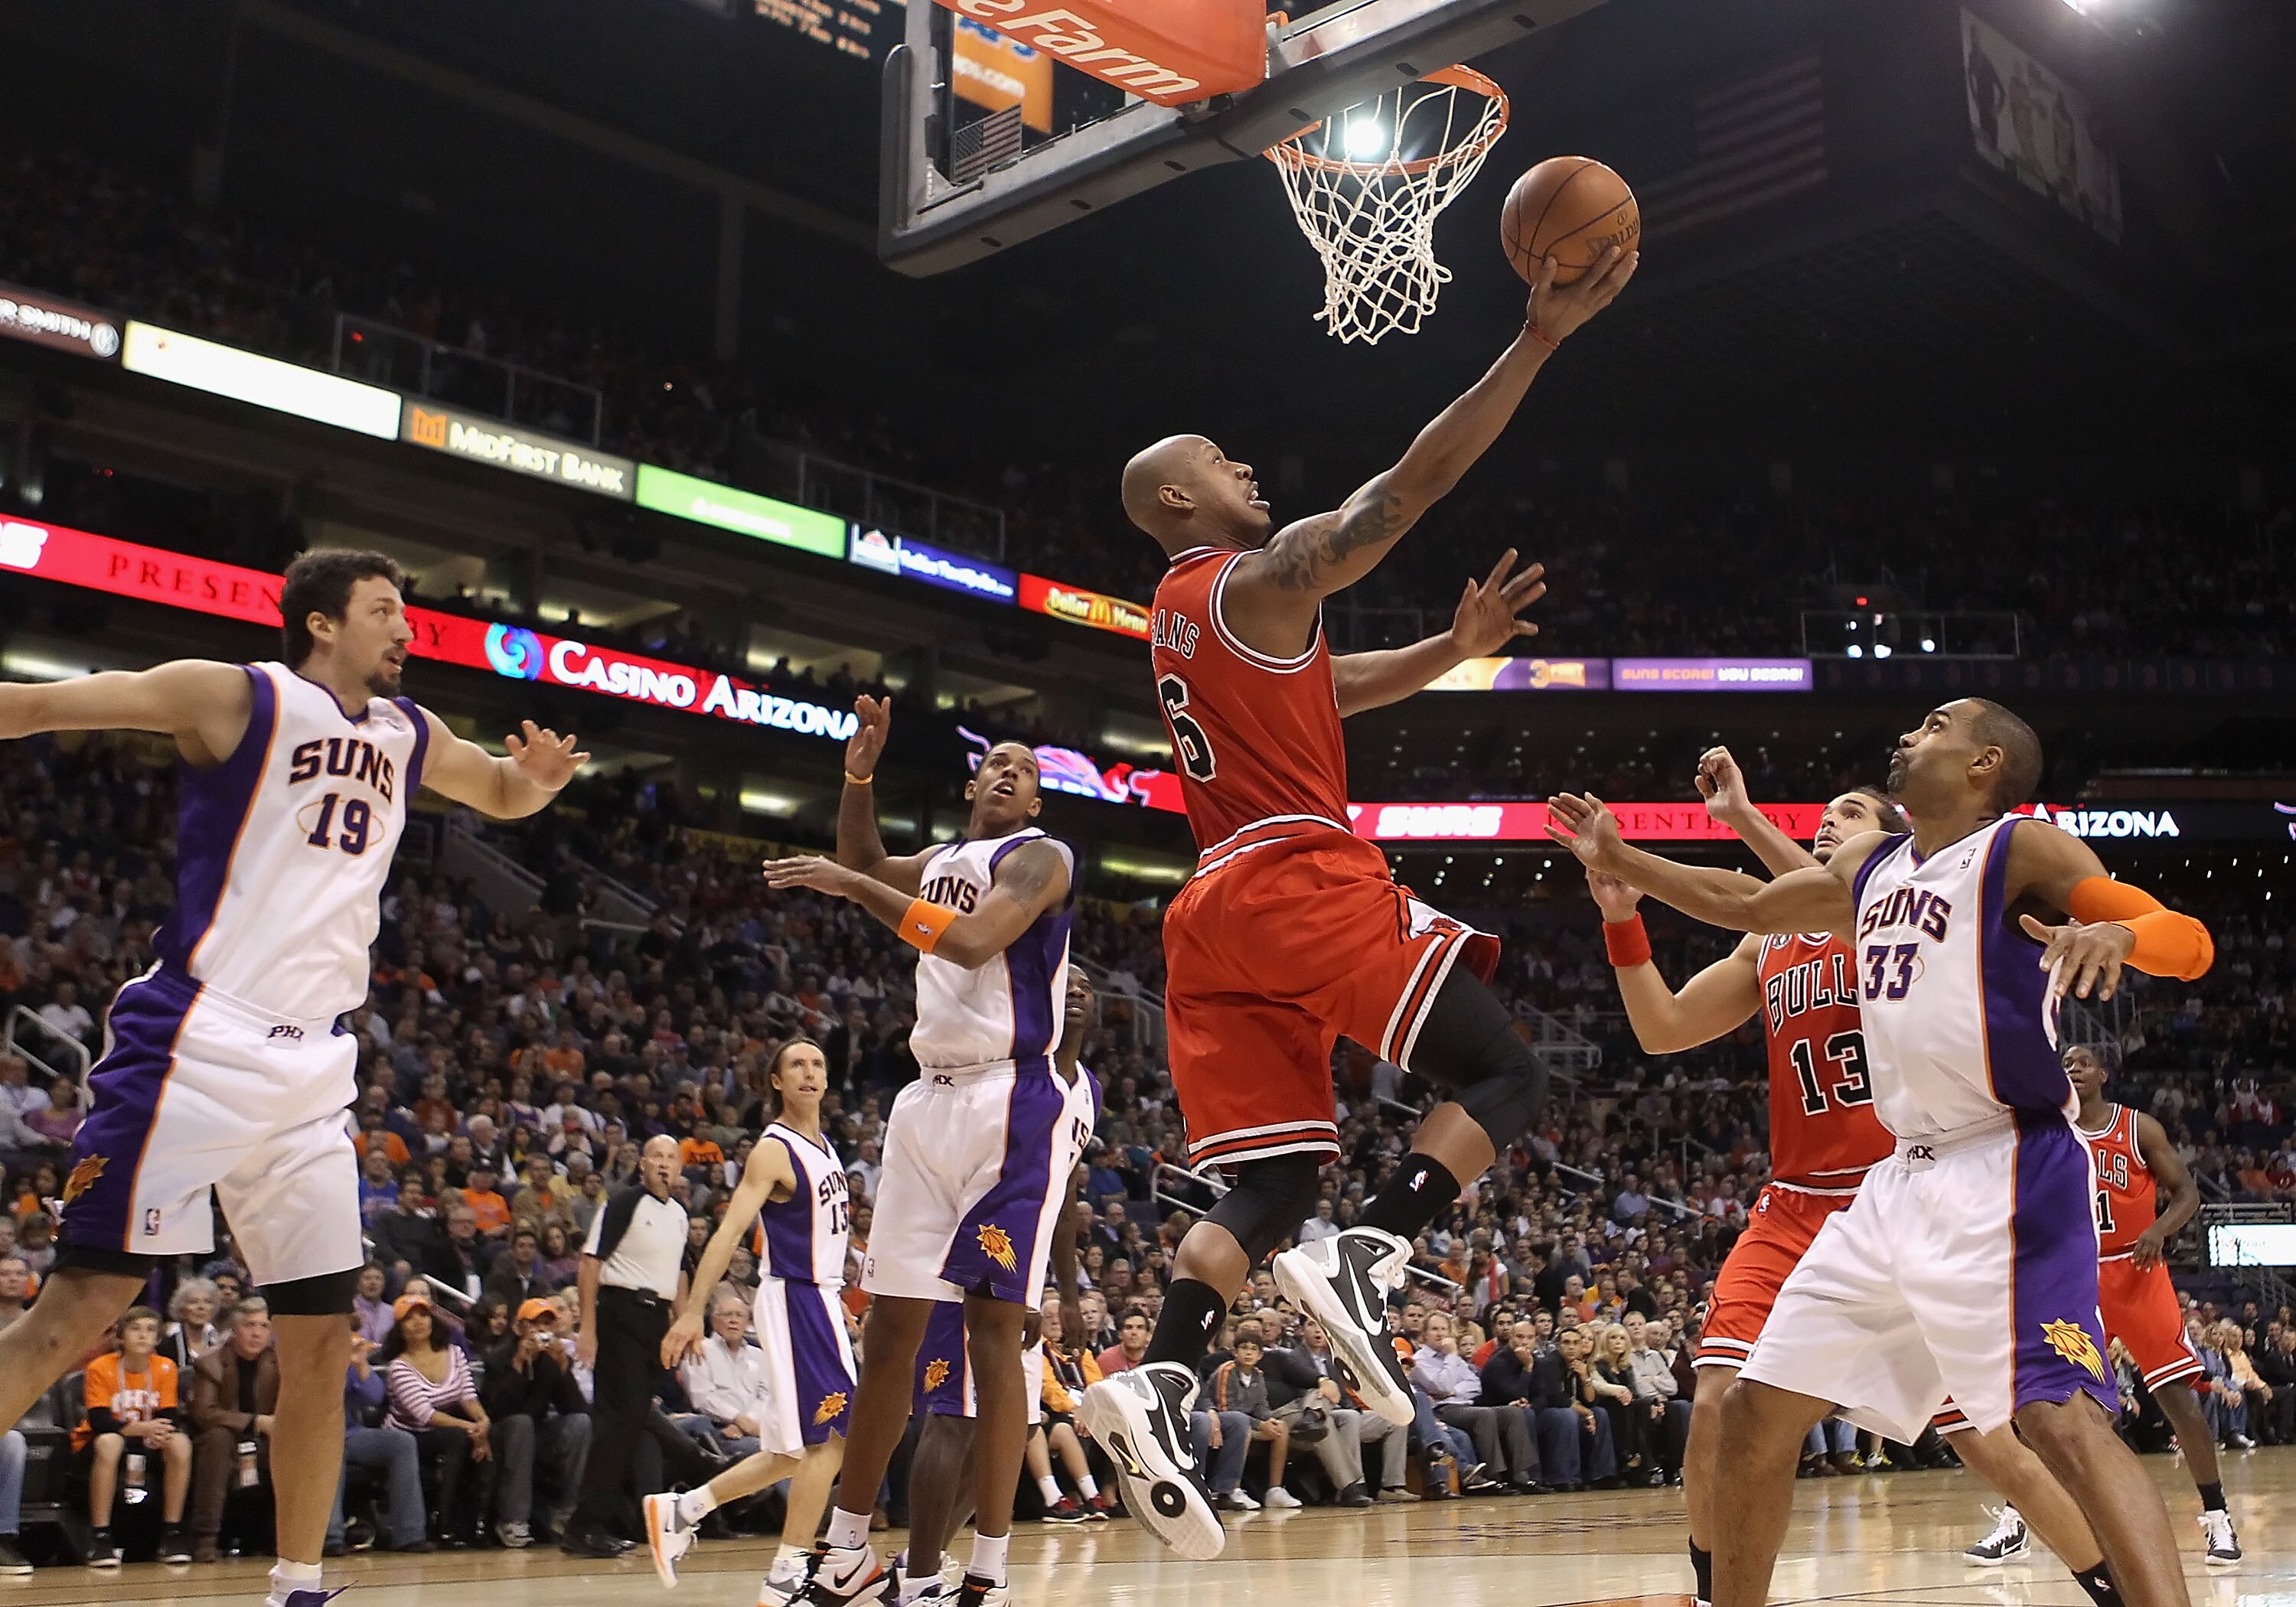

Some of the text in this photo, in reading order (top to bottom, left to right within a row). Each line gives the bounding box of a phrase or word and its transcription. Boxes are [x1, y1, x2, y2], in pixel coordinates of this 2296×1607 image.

[996, 8, 1200, 96] Farm
[107, 553, 285, 610] PRESEN
[1049, 586, 1148, 634] Dollar Menu
[1152, 608, 1200, 660] ANS
[548, 640, 696, 707] CASINO
[1158, 673, 1217, 783] 6
[289, 737, 394, 806] SUNS
[308, 793, 371, 856] 19
[1860, 887, 1953, 944] SUNS
[1766, 953, 1860, 1038] BULL
[1864, 943, 1920, 1003] 33
[1789, 1028, 1874, 1116] 13
